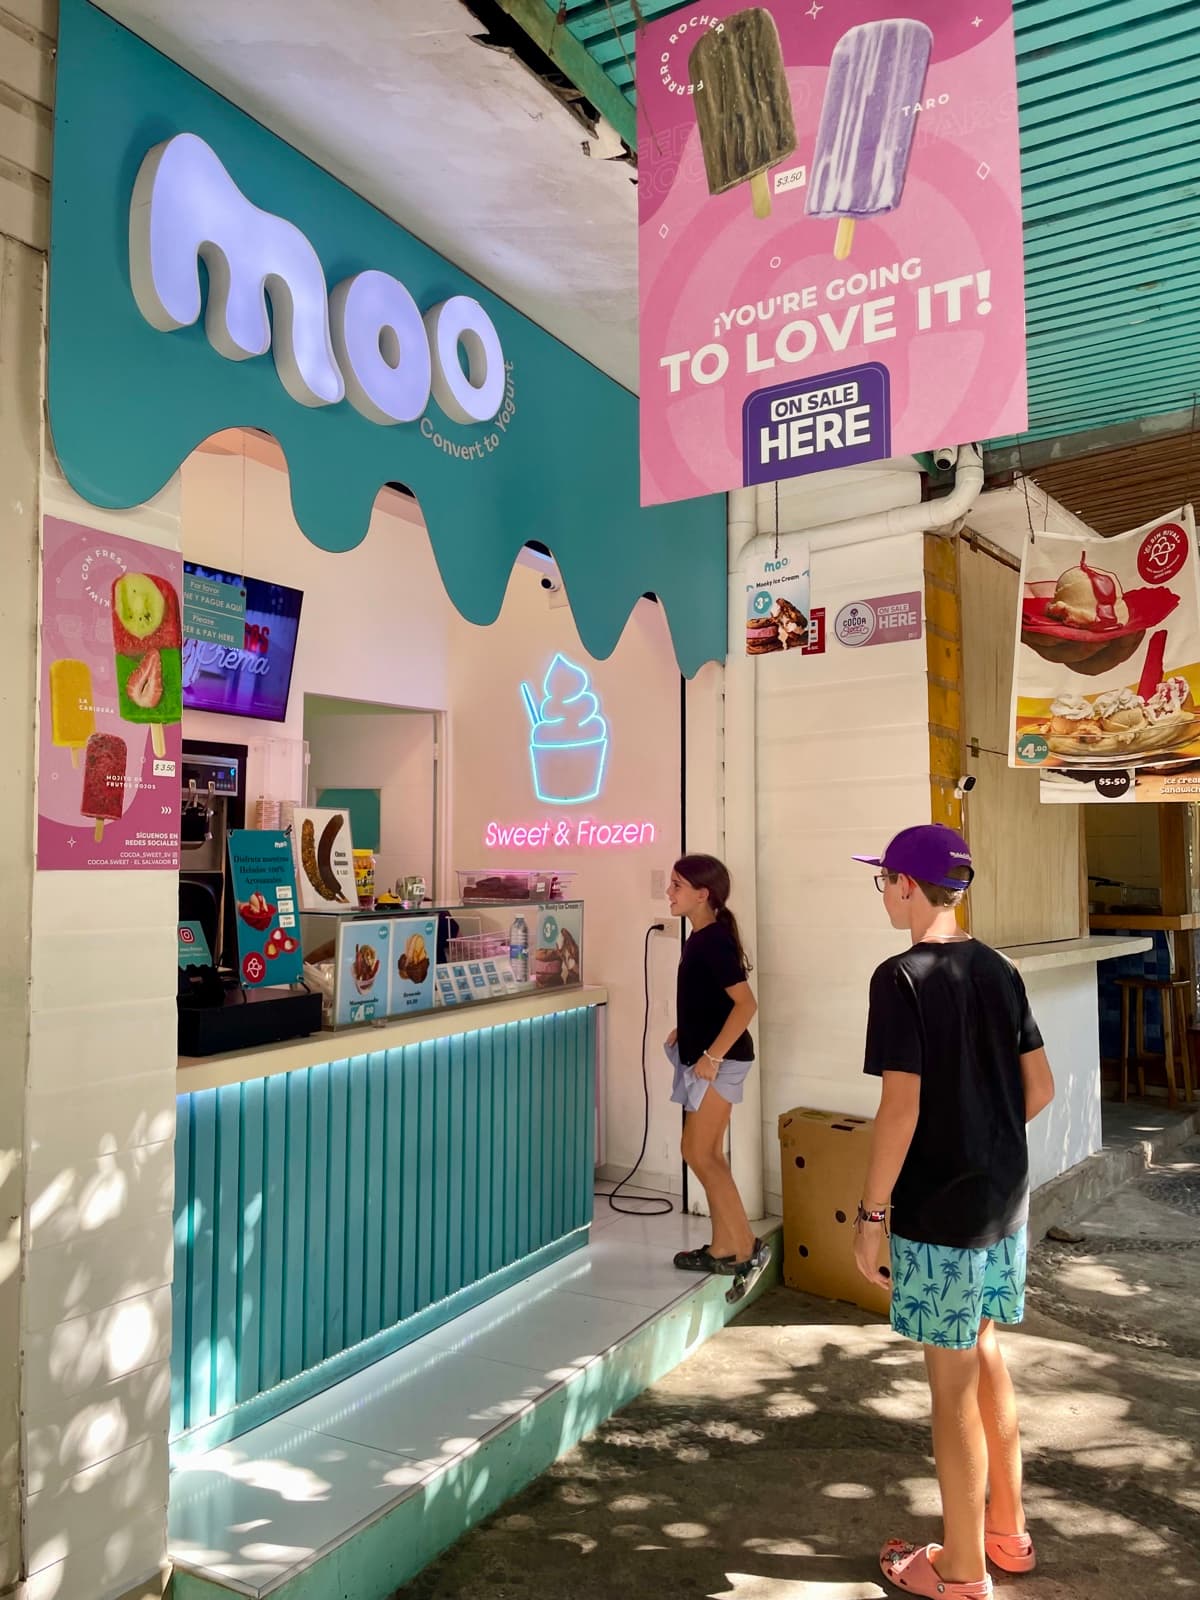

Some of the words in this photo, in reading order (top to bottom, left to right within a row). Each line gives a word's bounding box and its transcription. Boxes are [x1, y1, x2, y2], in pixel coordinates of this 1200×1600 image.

[669, 15, 725, 44] ROCHER
[660, 52, 704, 95] FERRERO
[901, 93, 950, 116] TARO
[775, 170, 803, 188] $3.50
[129, 132, 505, 426] moo
[826, 257, 922, 301] GOING
[659, 342, 729, 393] TO
[745, 295, 897, 374] LOVE
[916, 269, 993, 331] IT!
[420, 417, 485, 460] Convert
[483, 433, 499, 452] to
[494, 360, 516, 433] Yogurt
[774, 398, 803, 418] ON
[807, 385, 854, 411] SALE
[759, 404, 871, 464] HERE
[81, 555, 94, 581] CON
[95, 549, 127, 572] FRESA
[85, 586, 110, 608] KIWI
[201, 595, 225, 609] PAGUE
[890, 604, 908, 613] SALE
[843, 617, 867, 627] COCOA
[879, 611, 917, 629] HERE
[202, 629, 217, 639] PAY
[218, 632, 235, 643] HERE
[1098, 777, 1127, 786] $5.50
[485, 821, 550, 846] Sweet
[554, 821, 570, 846] &
[577, 820, 655, 846] Frozen
